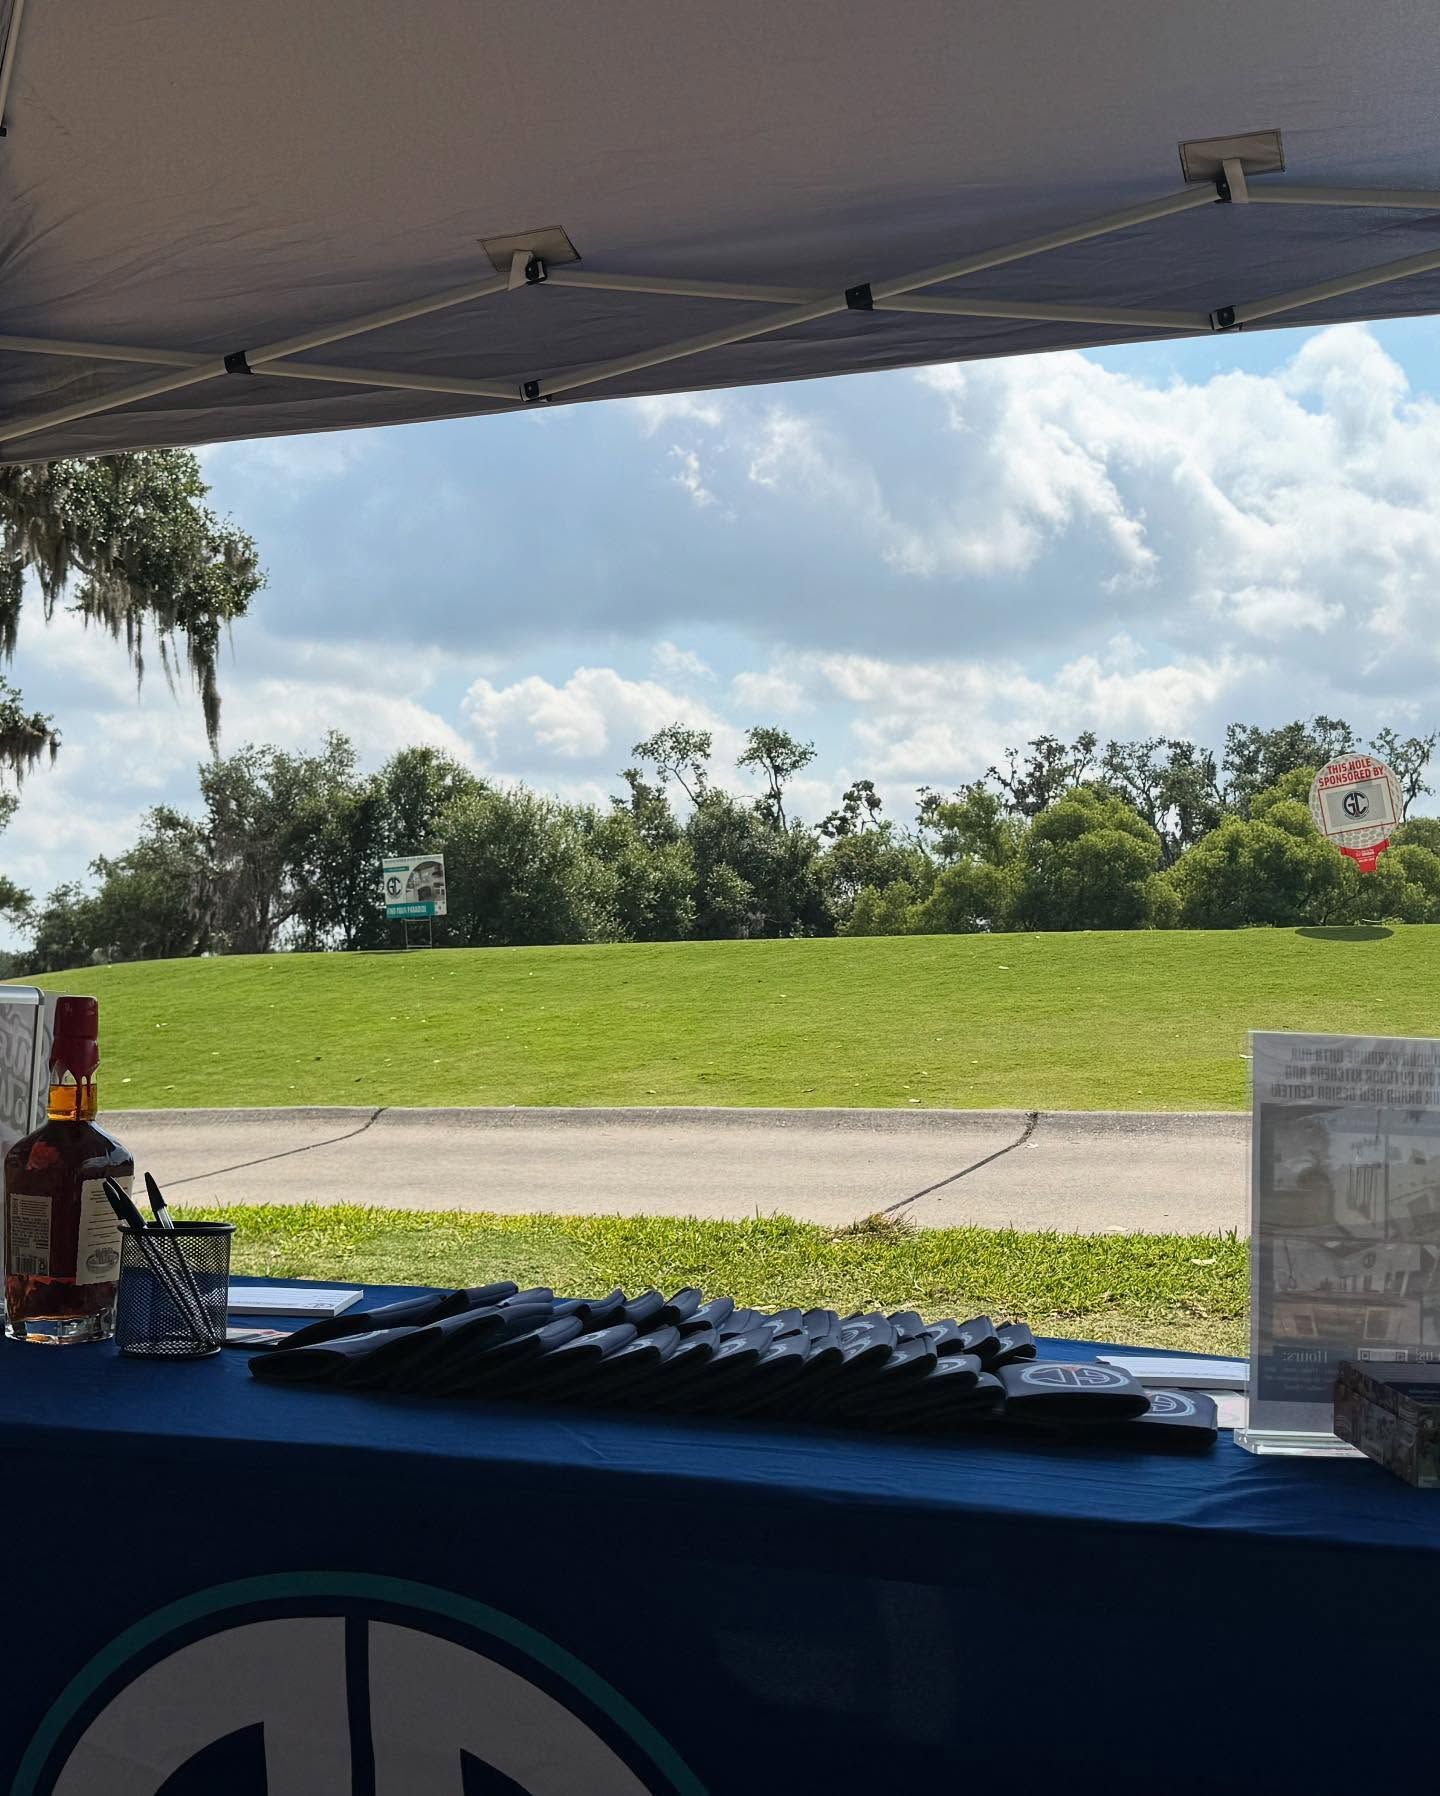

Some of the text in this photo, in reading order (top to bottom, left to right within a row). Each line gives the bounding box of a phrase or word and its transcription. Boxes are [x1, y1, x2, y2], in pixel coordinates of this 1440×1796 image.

[1327, 758, 1372, 775] THIS HOLE
[1318, 766, 1385, 787] SPONSORED BY
